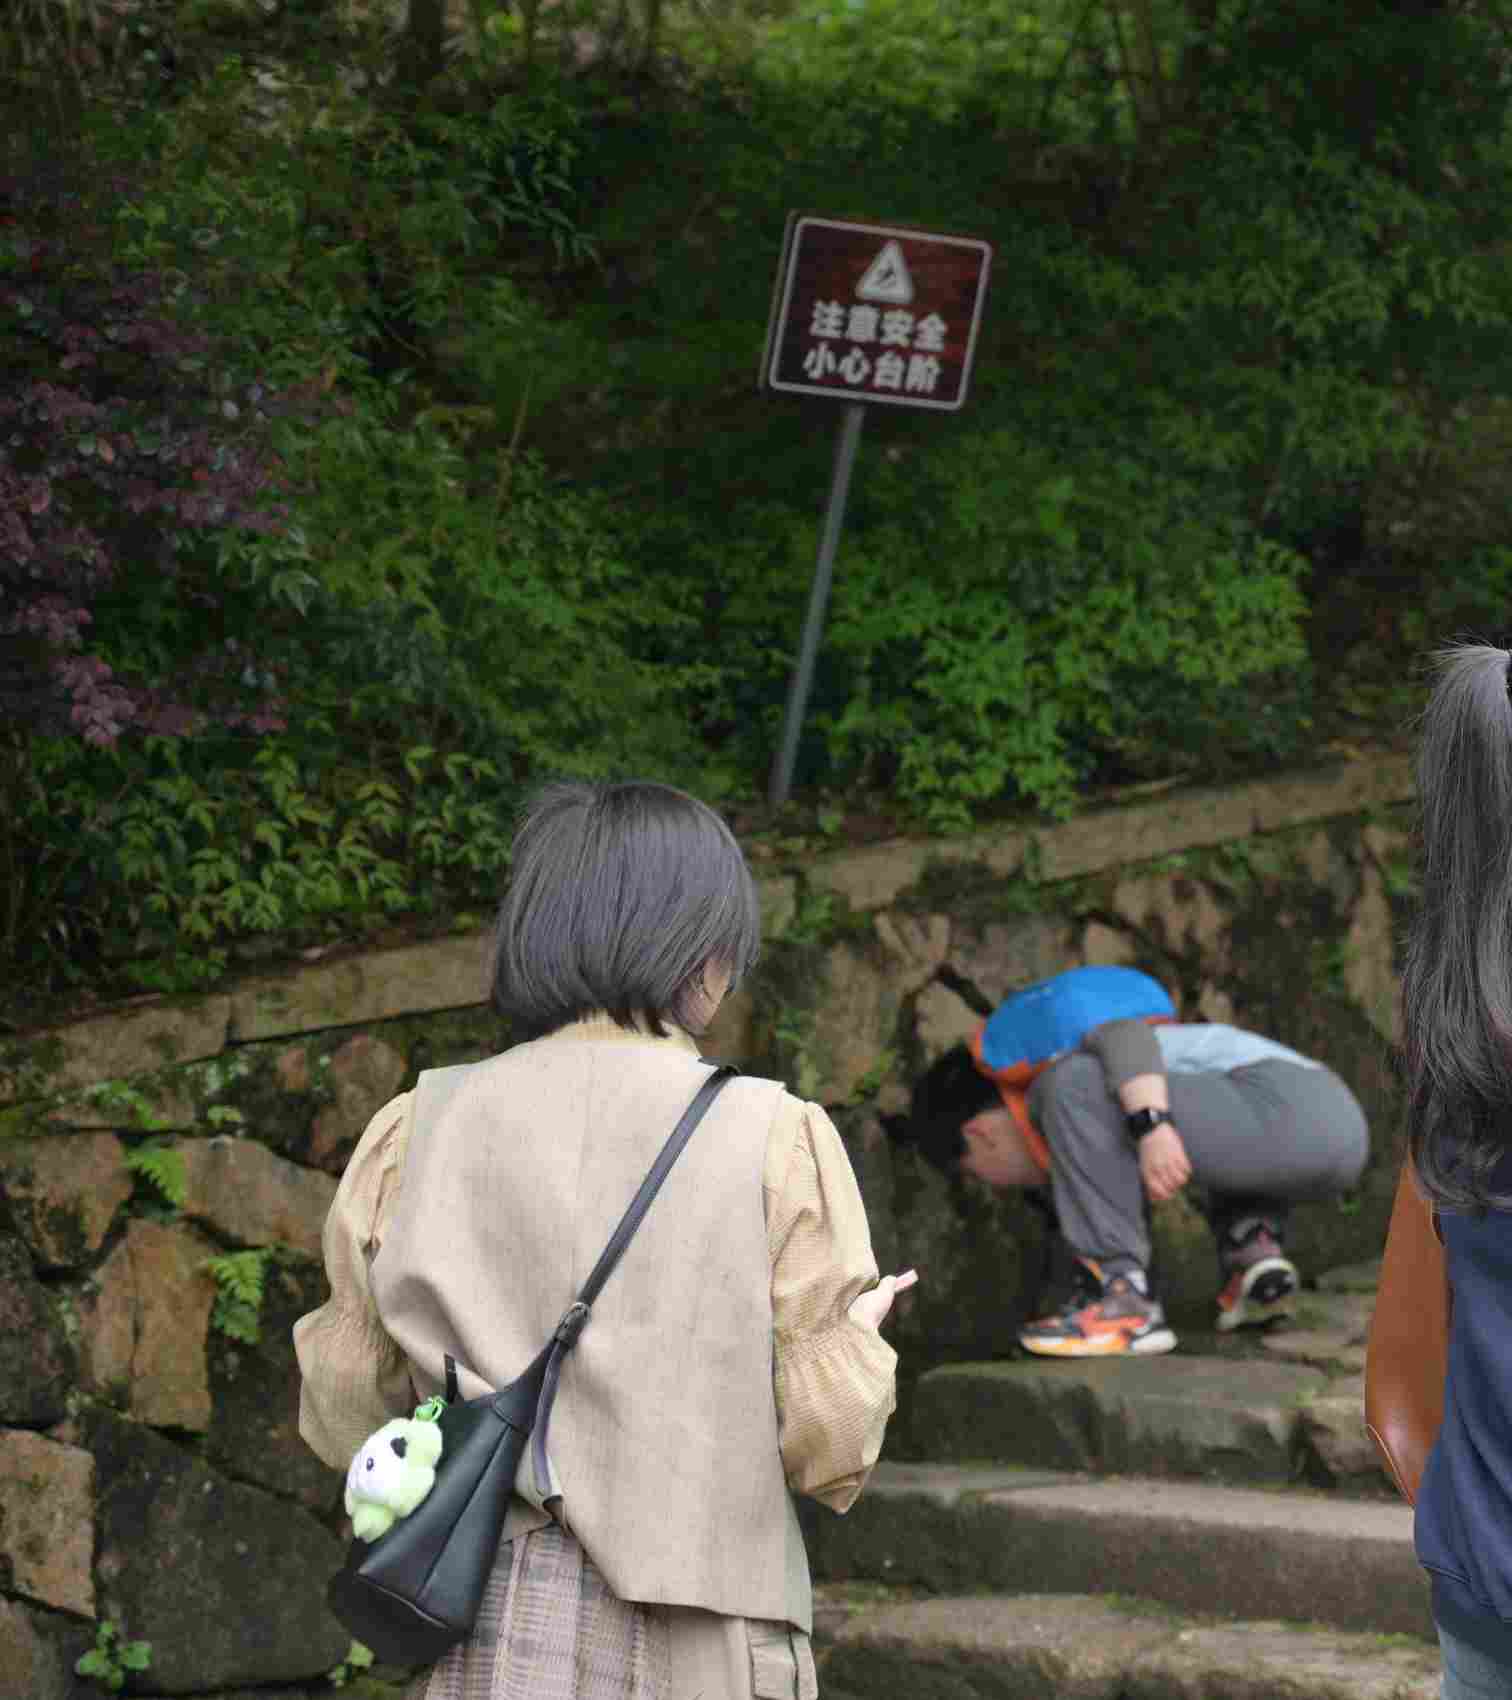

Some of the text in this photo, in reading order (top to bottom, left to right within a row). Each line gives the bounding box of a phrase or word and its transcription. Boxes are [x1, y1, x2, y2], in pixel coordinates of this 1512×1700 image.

[809, 299, 949, 352] 注意安全
[802, 341, 941, 392] 小心台阶
